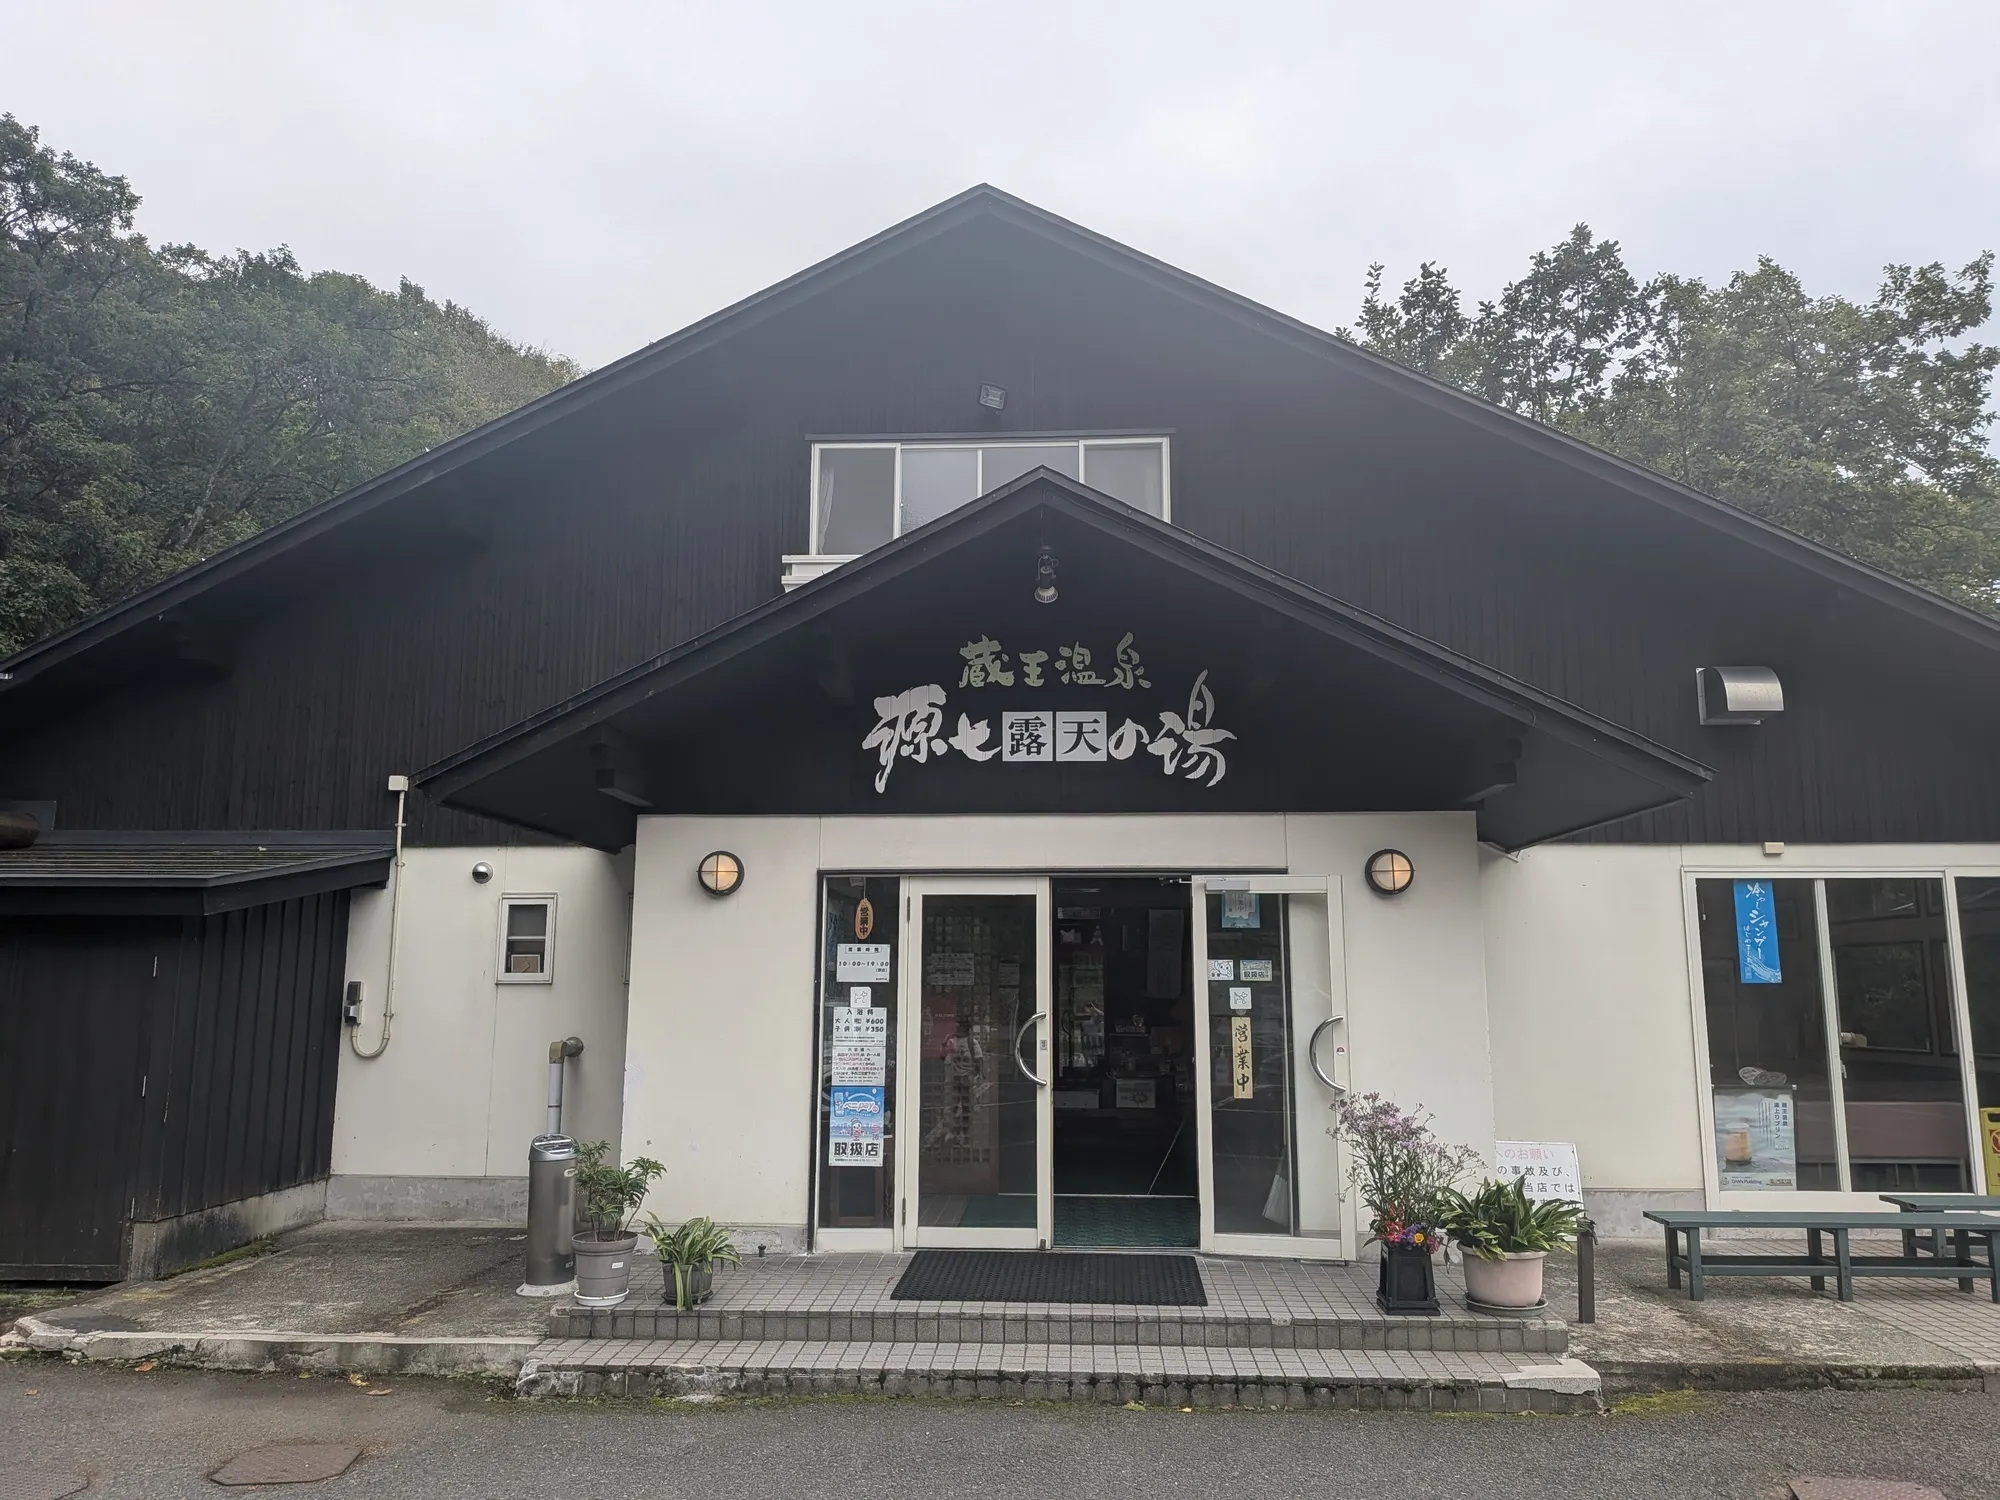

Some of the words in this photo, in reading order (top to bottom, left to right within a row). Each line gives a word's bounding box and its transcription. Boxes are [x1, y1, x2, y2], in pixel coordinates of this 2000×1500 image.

[958, 632, 1152, 690] 蔵王温泉
[860, 907, 869, 935] 営業中
[1234, 1024, 1251, 1092] 営業中
[834, 1142, 879, 1156] 取扱店
